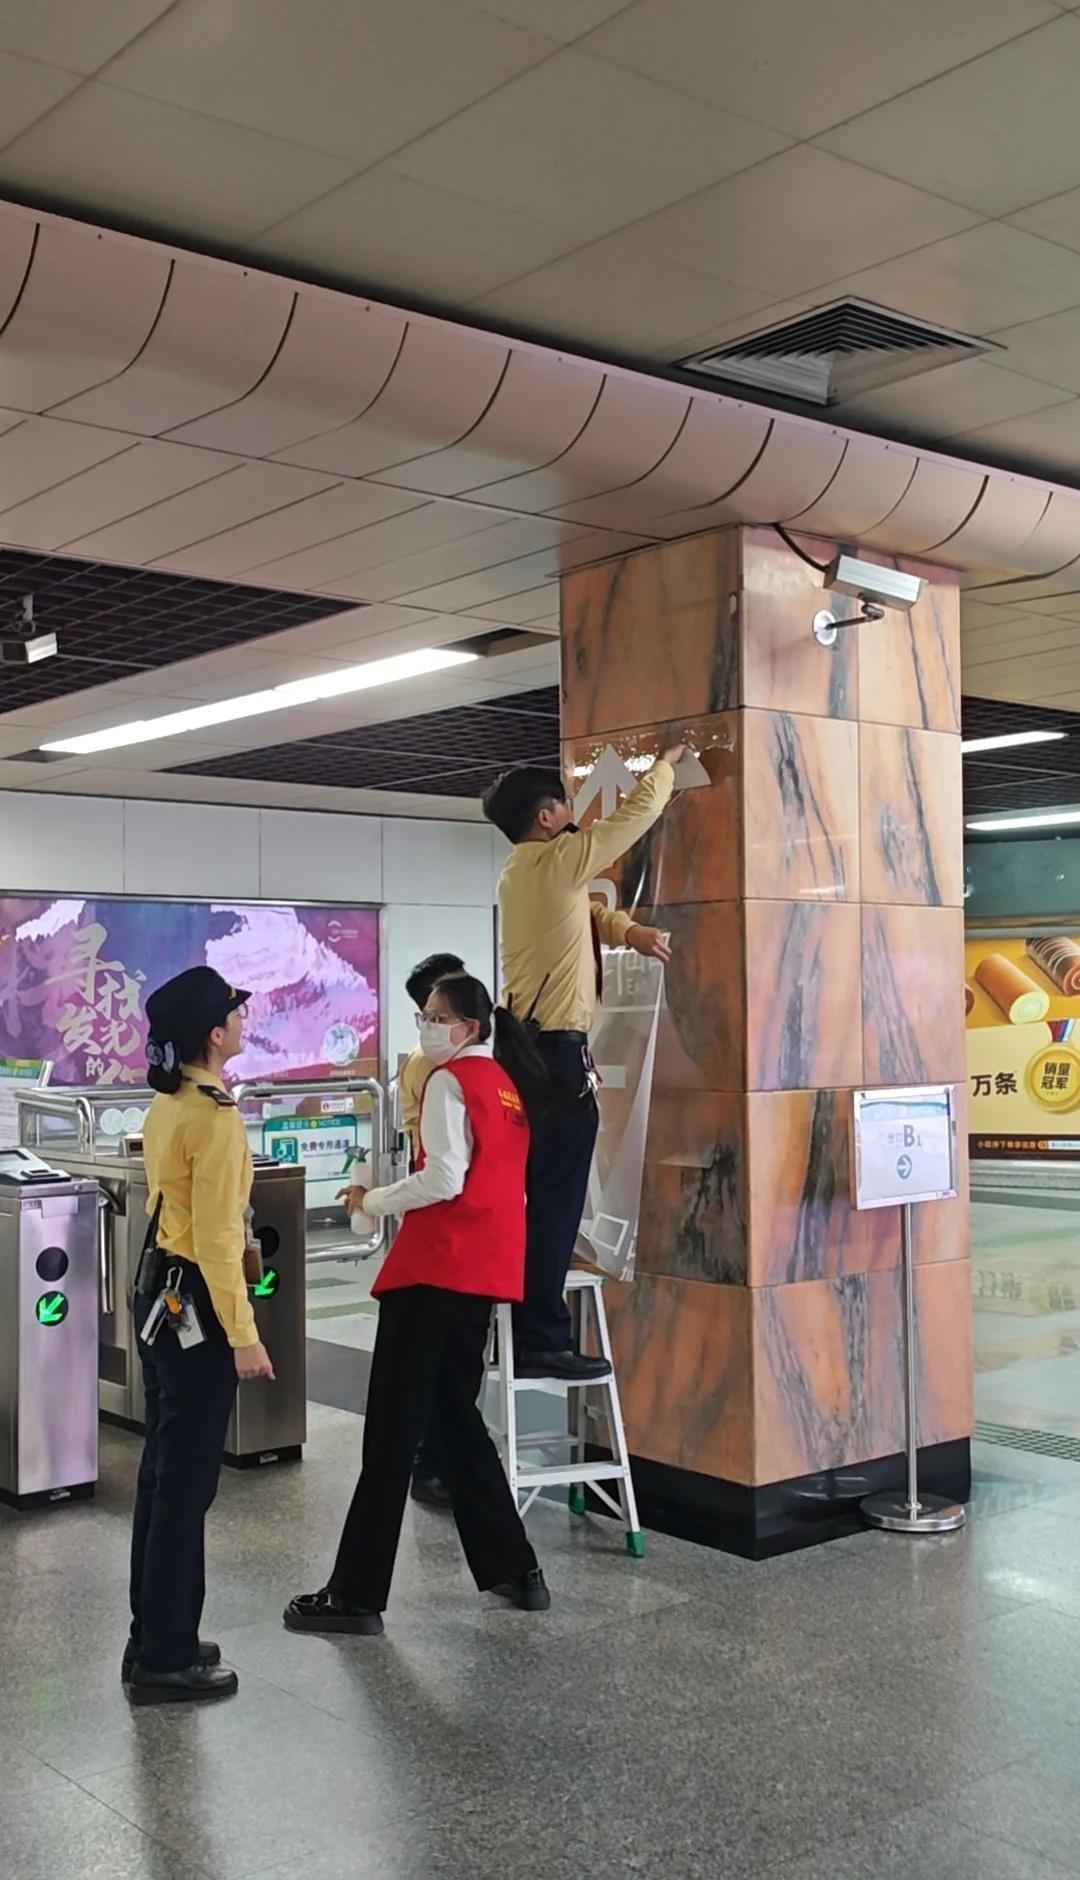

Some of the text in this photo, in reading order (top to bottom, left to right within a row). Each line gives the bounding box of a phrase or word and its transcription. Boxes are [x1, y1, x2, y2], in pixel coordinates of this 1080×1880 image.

[56, 1002, 141, 1057] 发光
[1044, 1061, 1071, 1076] 销量
[970, 1072, 1018, 1097] 万条
[1041, 1076, 1069, 1090] 冠军
